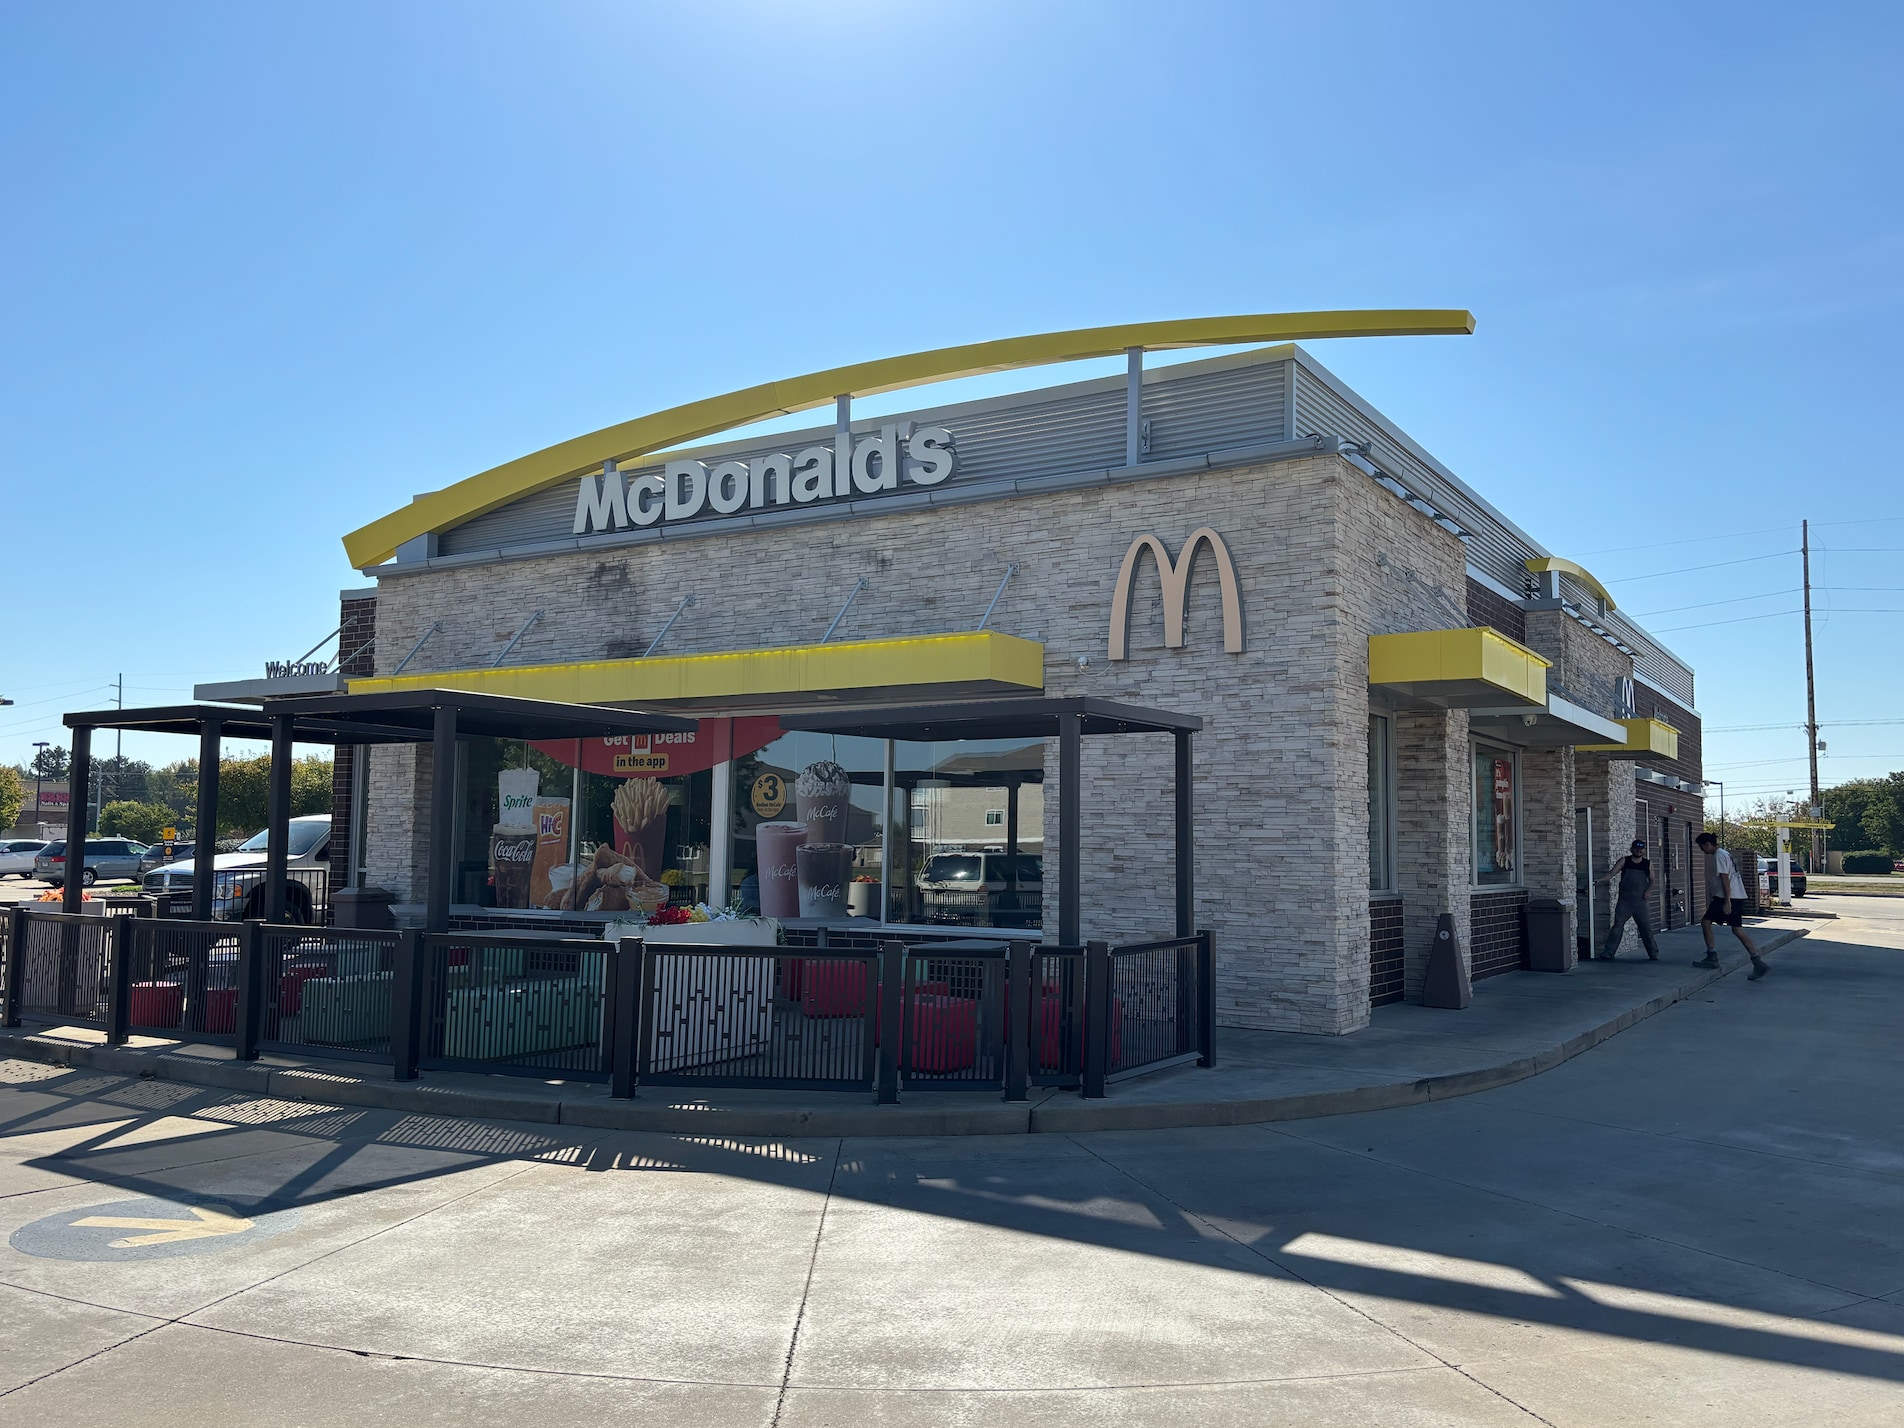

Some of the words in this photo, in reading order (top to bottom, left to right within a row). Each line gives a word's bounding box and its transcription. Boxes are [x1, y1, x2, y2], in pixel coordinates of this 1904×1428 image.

[572, 420, 958, 535] McDonald's
[265, 660, 328, 679] Welcome
[603, 735, 629, 747] Get
[655, 732, 696, 745] Deals
[616, 756, 626, 767] in
[628, 757, 645, 767] the
[646, 757, 666, 769] app
[503, 794, 533, 810] Sprite
[807, 805, 839, 821] McCafé
[765, 864, 797, 880] McCafé
[807, 884, 841, 901] McCafé
